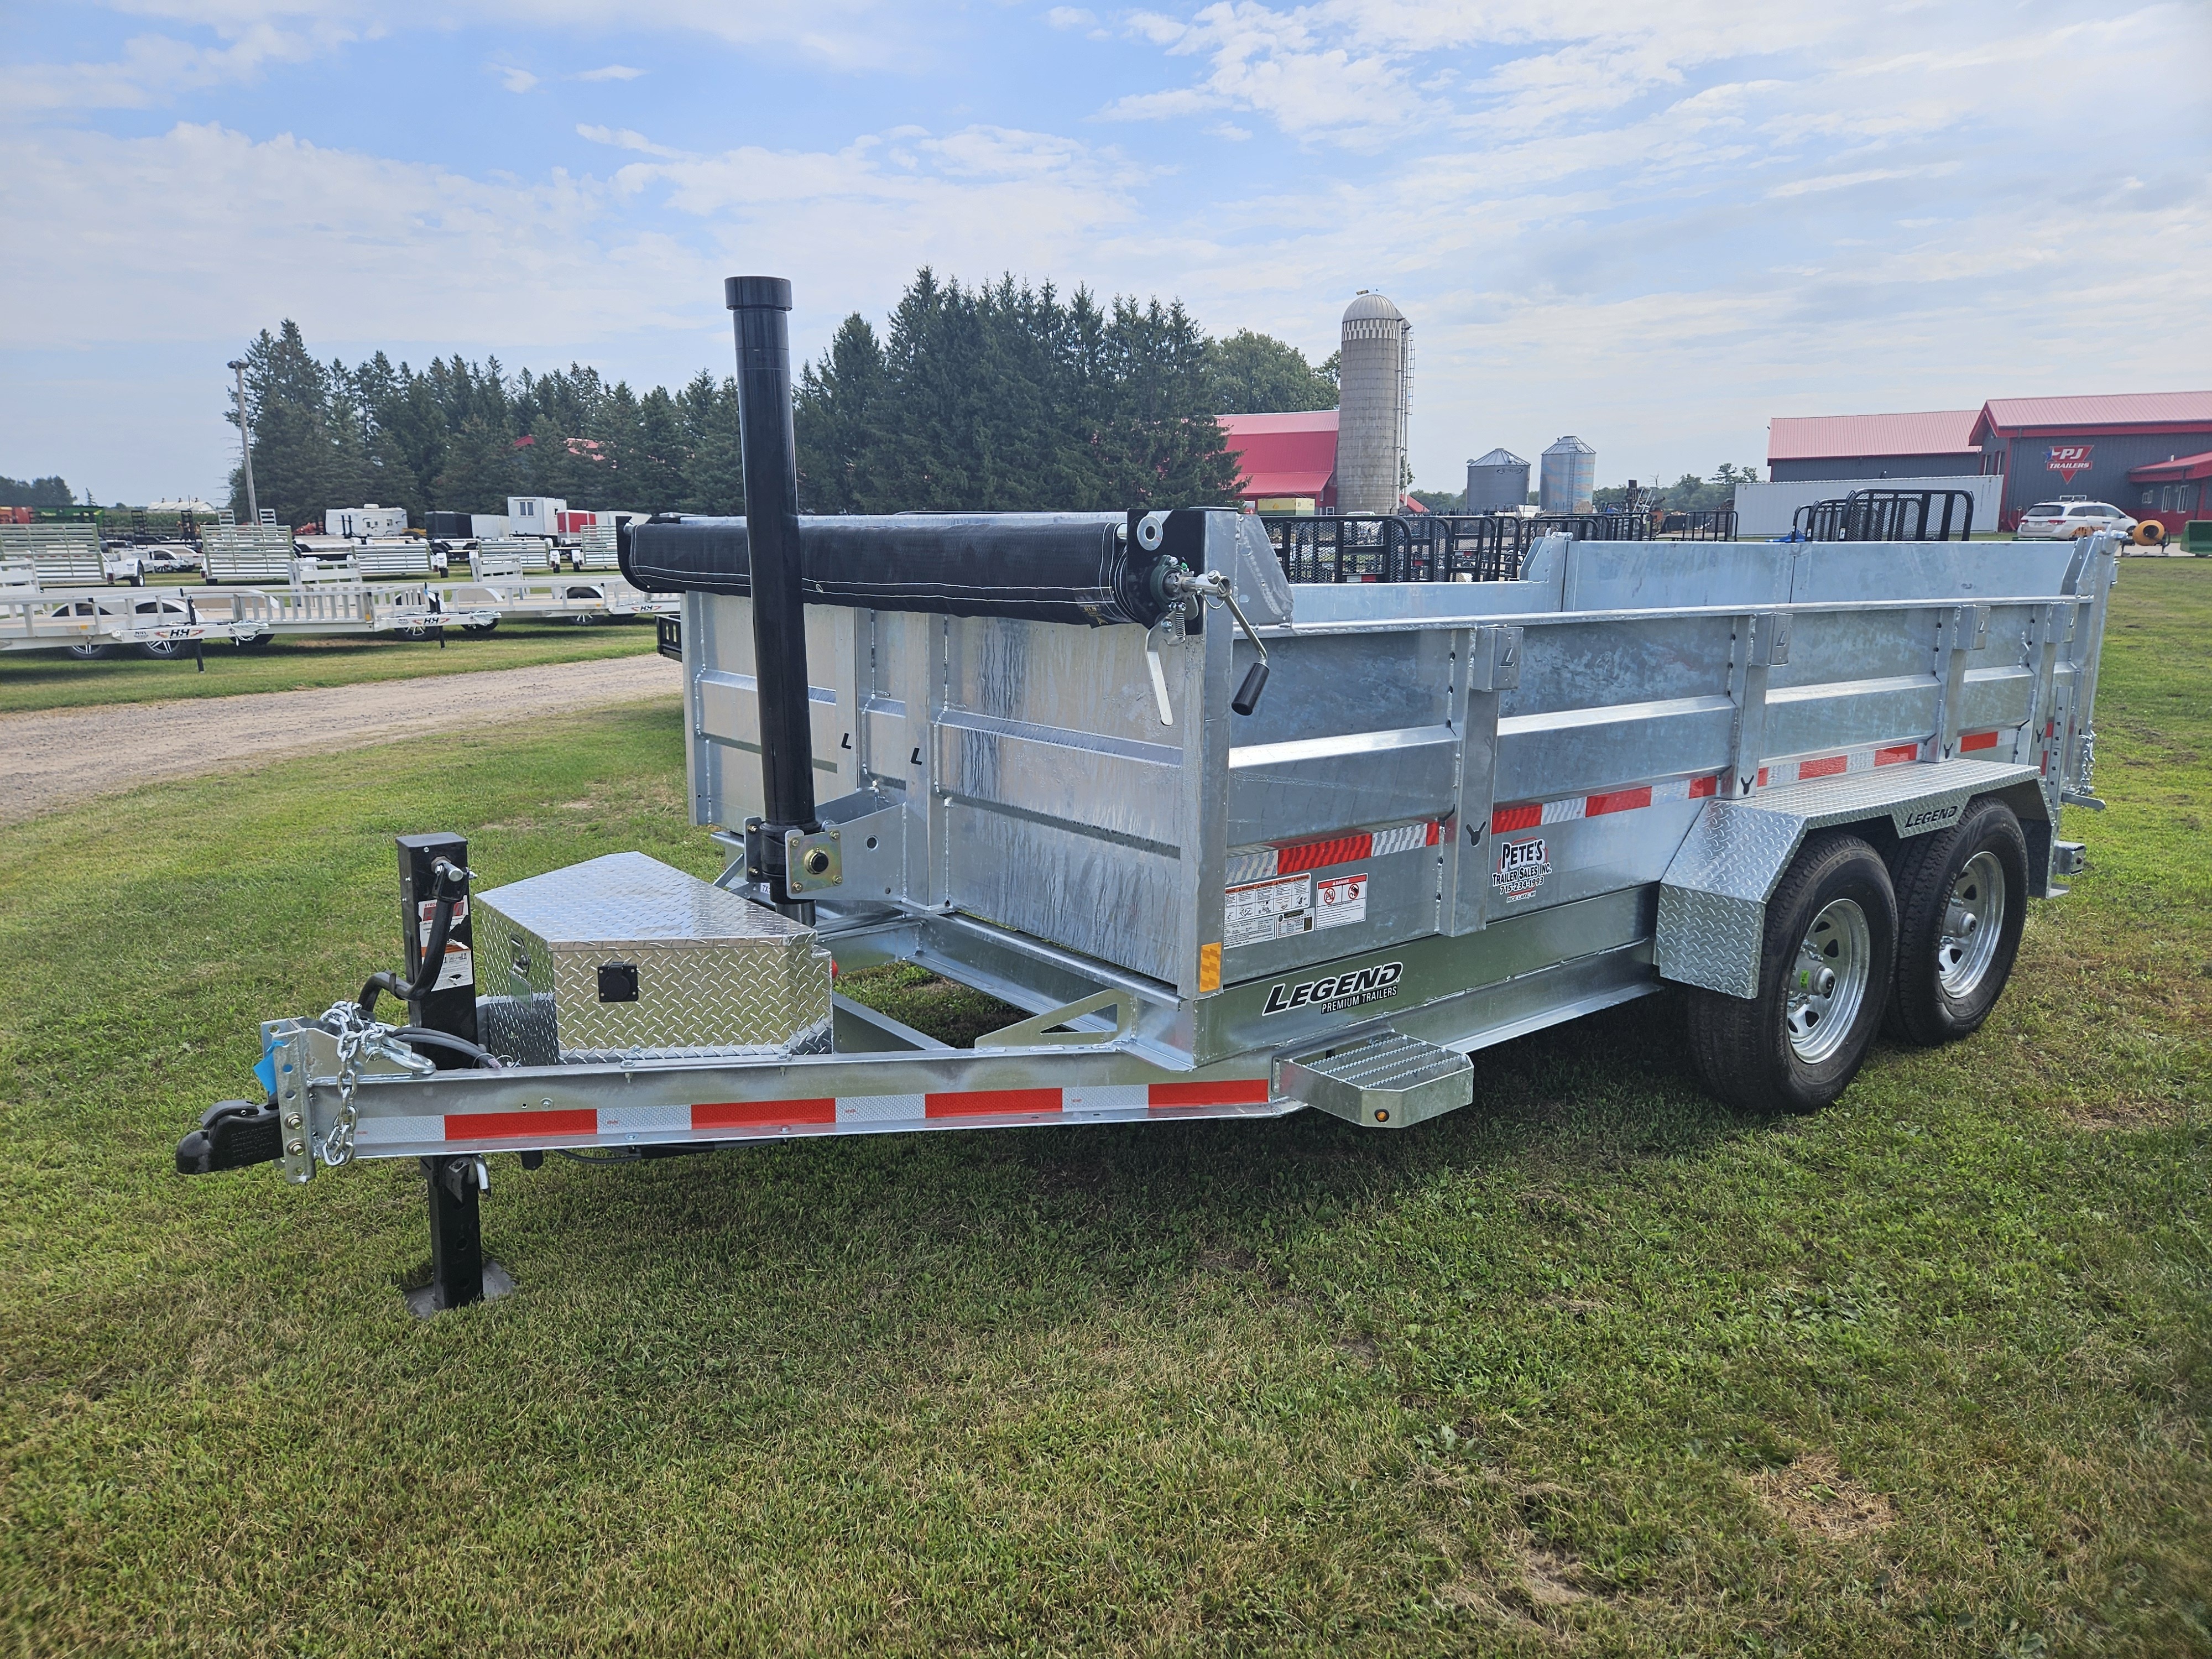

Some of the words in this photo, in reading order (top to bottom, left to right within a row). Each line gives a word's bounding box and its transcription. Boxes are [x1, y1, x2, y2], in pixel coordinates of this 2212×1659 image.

[2059, 448, 2084, 460] PJ
[1905, 805, 1958, 828] LEGEND
[1501, 839, 1543, 870] PETE'S
[1493, 870, 1517, 886] TRAILER
[1519, 866, 1537, 879] SALES
[1540, 863, 1551, 874] INC.
[1500, 877, 1543, 894] 715-234-1993
[1263, 963, 1402, 1015] LEGEND
[1322, 995, 1359, 1013] PREMIUM
[1362, 986, 1397, 1003] TRAILERS
